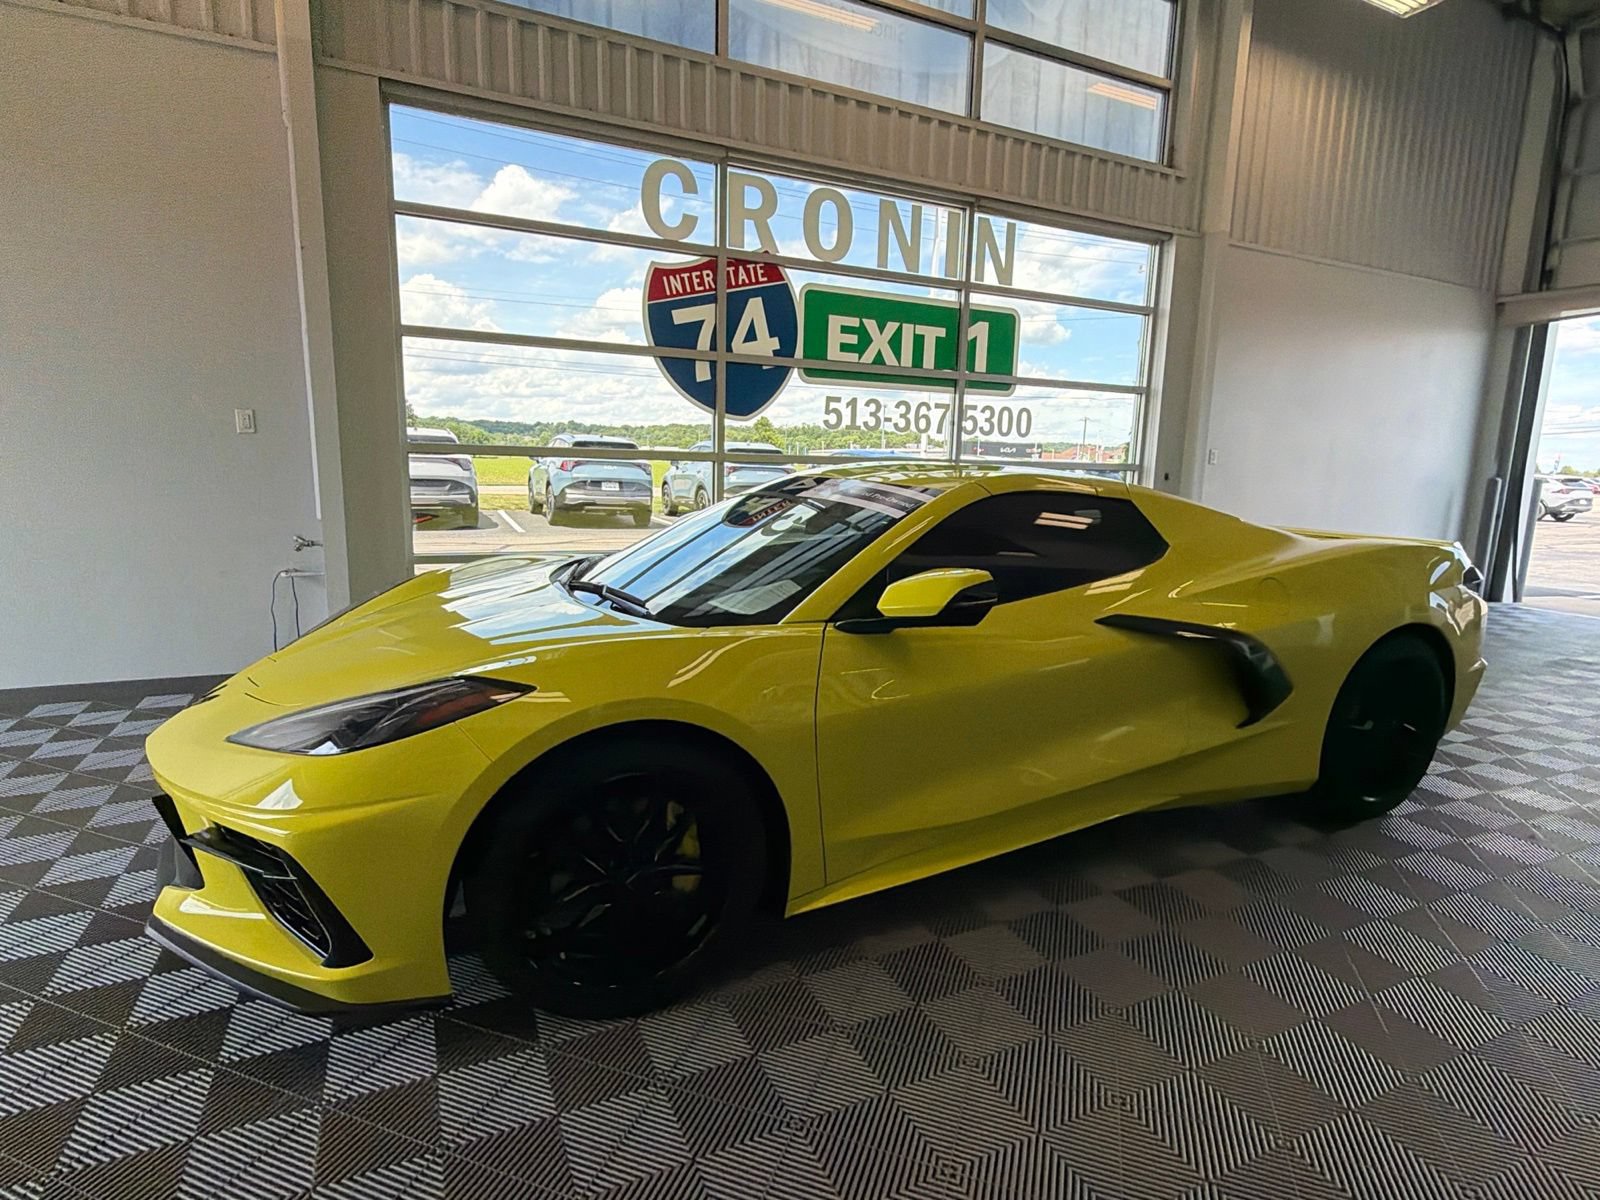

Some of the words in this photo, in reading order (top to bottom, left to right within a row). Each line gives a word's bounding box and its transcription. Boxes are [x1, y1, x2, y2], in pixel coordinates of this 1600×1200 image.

[640, 158, 1017, 287] CRONIN
[662, 263, 768, 296] INTERTATE
[671, 296, 781, 383] 74
[827, 314, 947, 370] EXIT
[966, 321, 990, 374] 1
[823, 395, 1033, 438] 513-3675300
